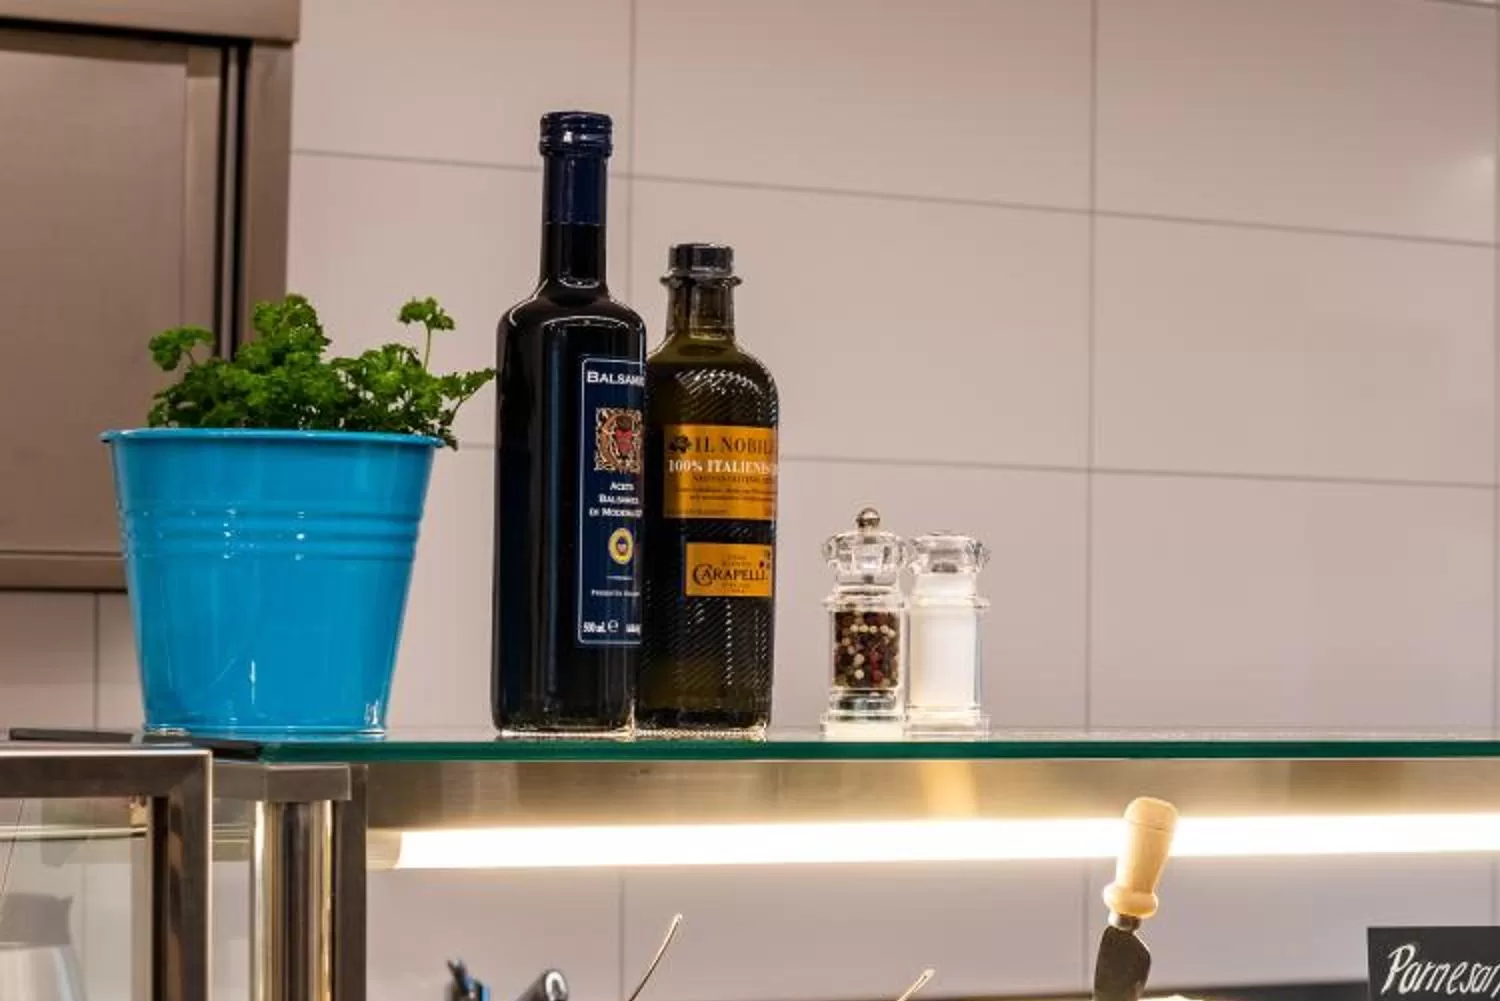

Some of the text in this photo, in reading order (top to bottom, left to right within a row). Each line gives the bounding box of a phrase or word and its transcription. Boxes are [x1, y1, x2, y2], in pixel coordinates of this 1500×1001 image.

[695, 436, 774, 455] IL NOBIL
[669, 459, 703, 473] 100%
[693, 564, 767, 586] CARAPELLI
